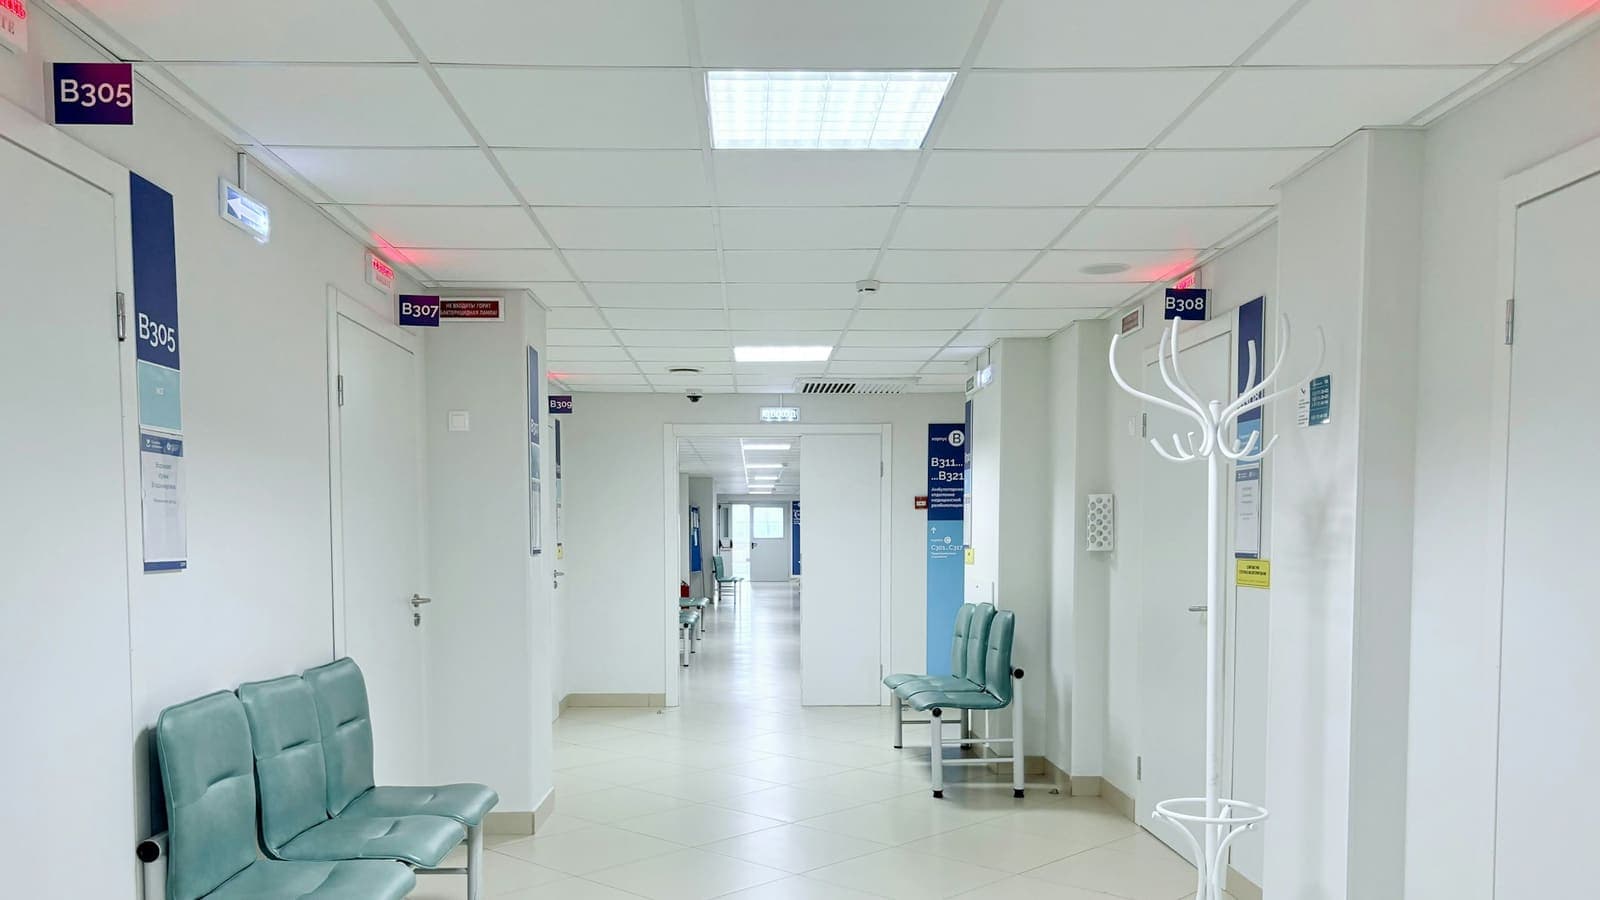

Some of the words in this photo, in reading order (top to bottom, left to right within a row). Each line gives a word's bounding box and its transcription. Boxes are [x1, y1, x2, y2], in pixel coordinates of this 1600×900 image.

[60, 79, 132, 108] B305
[402, 302, 439, 318] B307
[1166, 296, 1204, 312] B308
[138, 312, 176, 353] B305
[550, 400, 572, 409] B309
[952, 433, 962, 444] B
